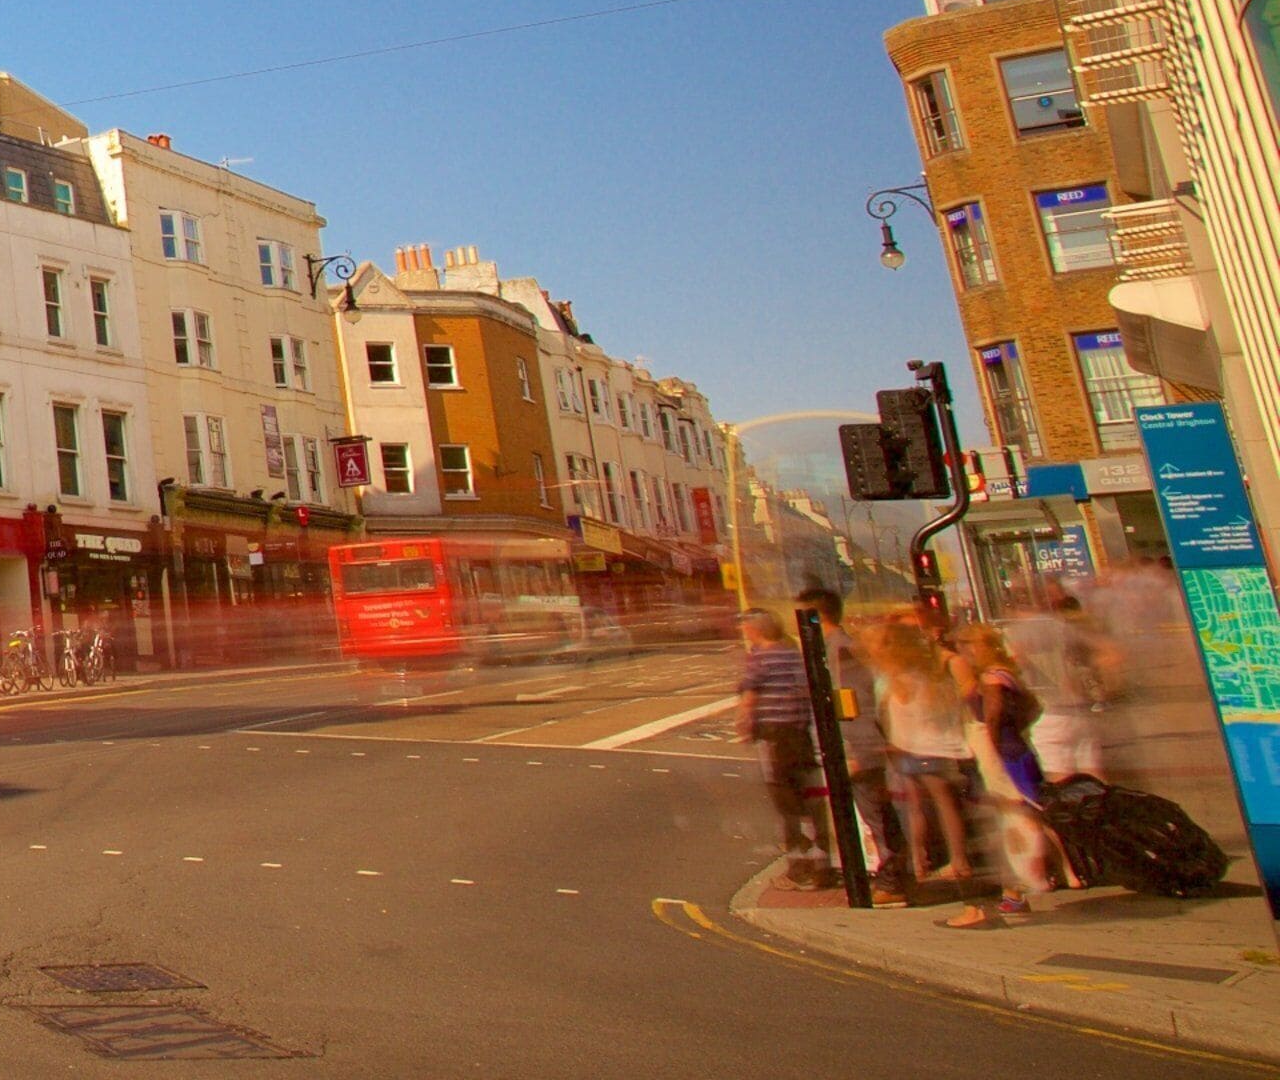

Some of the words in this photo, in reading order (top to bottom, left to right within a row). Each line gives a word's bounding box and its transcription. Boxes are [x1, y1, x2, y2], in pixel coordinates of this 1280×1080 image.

[1057, 190, 1084, 202] REED
[1099, 464, 1141, 476] 132
[75, 533, 104, 550] THE
